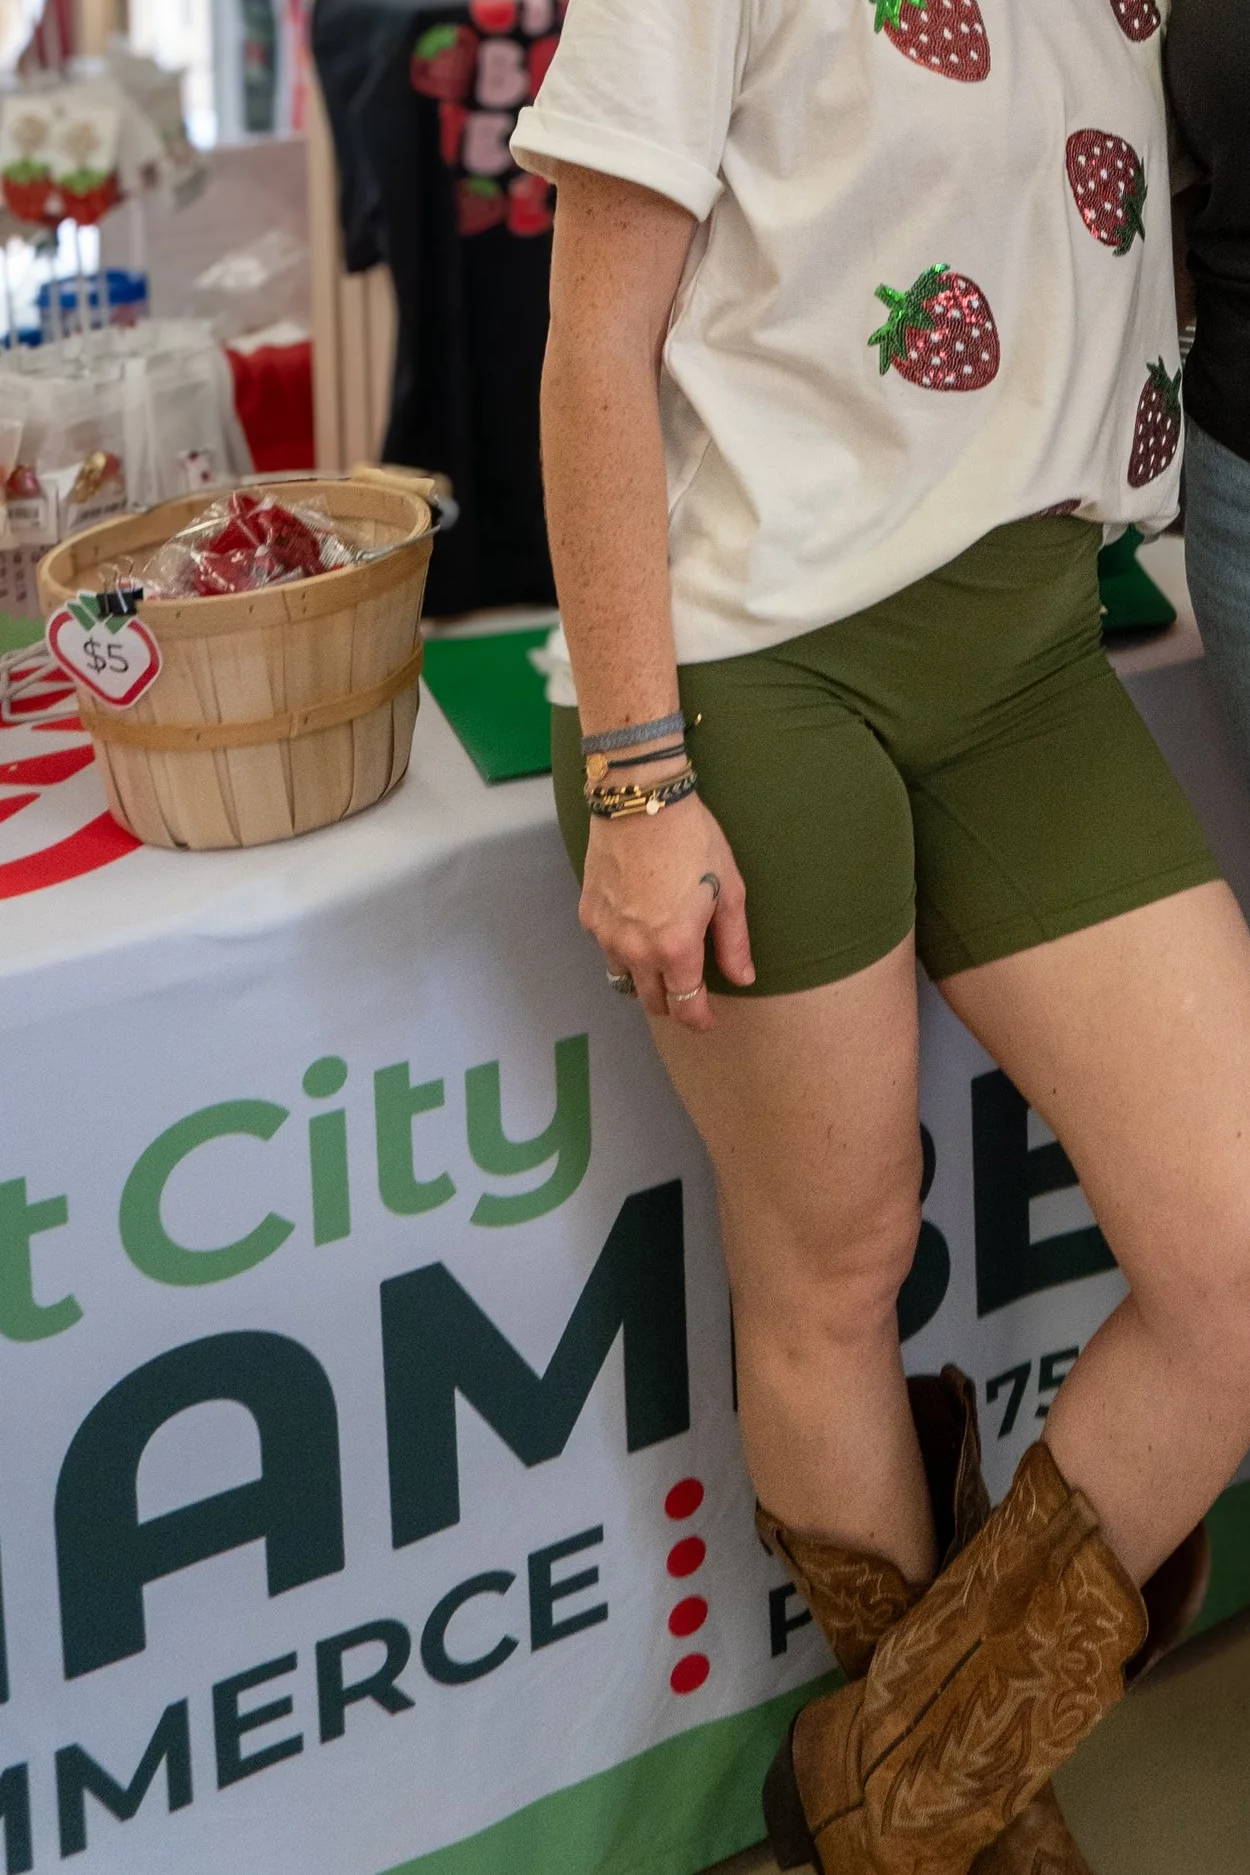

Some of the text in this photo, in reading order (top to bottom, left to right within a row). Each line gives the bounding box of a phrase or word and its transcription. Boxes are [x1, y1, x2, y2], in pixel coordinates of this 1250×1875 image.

[82, 636, 130, 674] $5
[118, 1032, 592, 1287] City
[0, 1525, 609, 1875] MERCE
